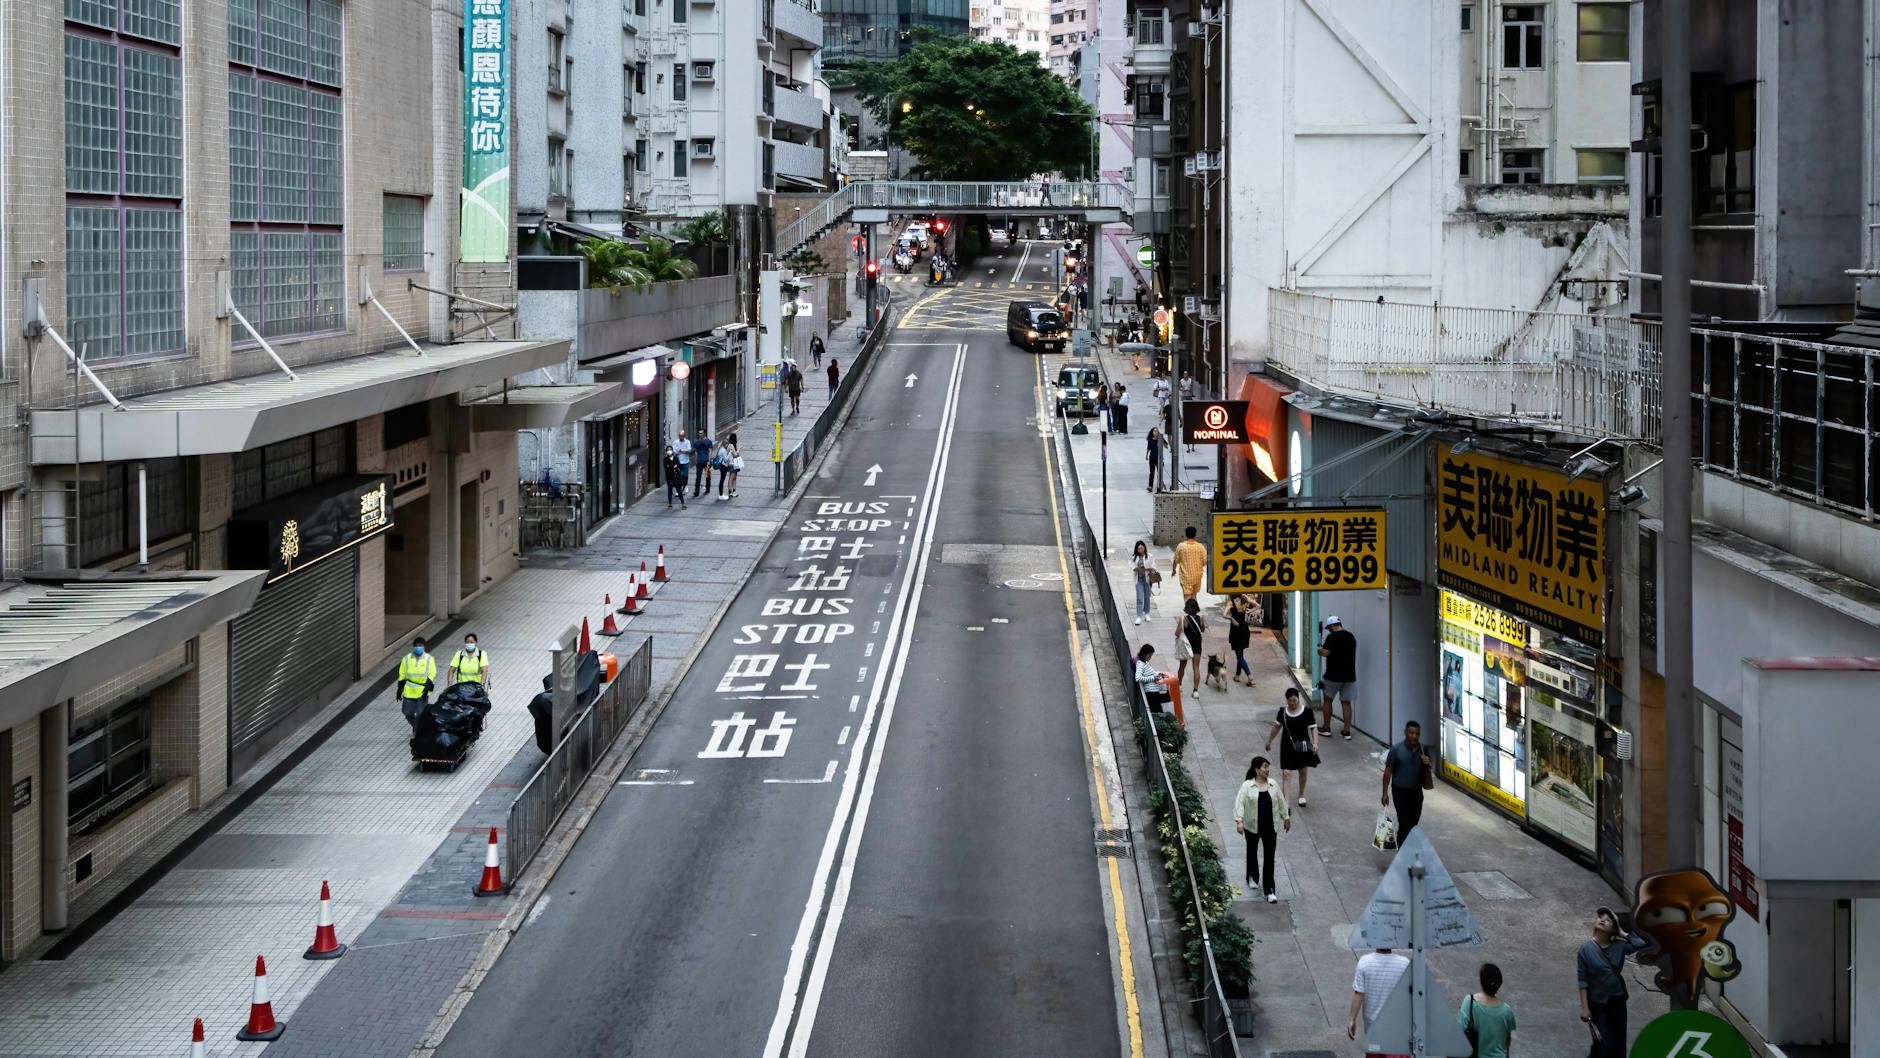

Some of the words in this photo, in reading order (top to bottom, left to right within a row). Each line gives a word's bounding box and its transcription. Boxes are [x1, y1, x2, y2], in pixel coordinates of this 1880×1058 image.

[1193, 430, 1239, 439] NOMINAL
[817, 502, 889, 515] BUS
[1443, 458, 1598, 583] 美聯物業
[801, 519, 892, 532] STOP
[1222, 517, 1378, 557] 美聯物業
[794, 536, 873, 561] 巴士
[787, 565, 852, 591] 站
[1222, 557, 1295, 588] 2526
[1305, 555, 1378, 585] 8999
[1443, 542, 1519, 585] MIDLAND
[1529, 572, 1598, 615] REALTY
[761, 598, 854, 616] BUS
[733, 624, 854, 644] STOP
[1474, 604, 1496, 632] 2526
[1499, 613, 1524, 642] 8999
[715, 653, 830, 693] 巴士
[697, 711, 797, 758] 站
